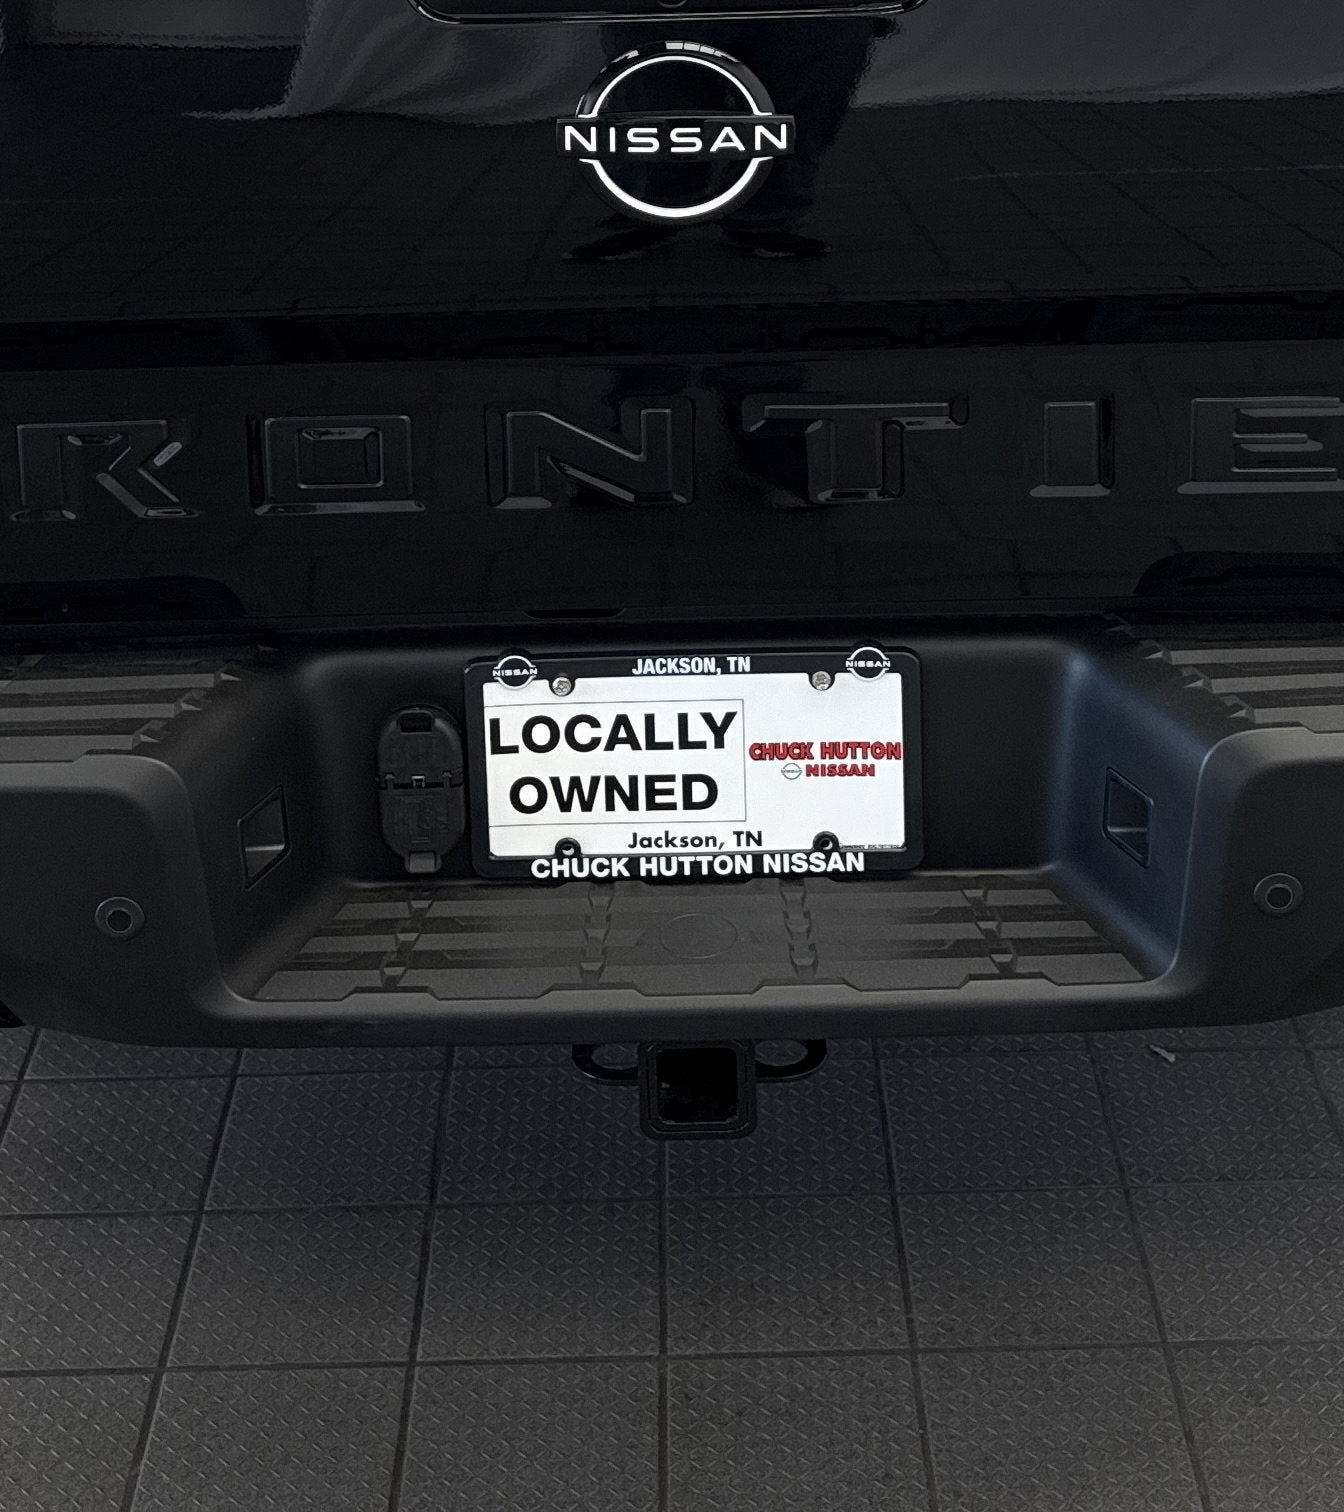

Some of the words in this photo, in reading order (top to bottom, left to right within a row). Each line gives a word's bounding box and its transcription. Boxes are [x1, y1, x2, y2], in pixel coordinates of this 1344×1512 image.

[564, 123, 787, 153] NISSAN
[492, 668, 538, 677] NISSAN
[631, 657, 721, 676] JACKSON,
[727, 656, 751, 673] TN
[845, 660, 891, 668] NISSAN
[489, 711, 738, 755] LOCALLY
[749, 742, 814, 761] CHUCK
[820, 741, 902, 760] HUTTON
[805, 763, 876, 777] NISSAN
[509, 774, 718, 814] OWNED
[628, 830, 725, 850] Jackson,
[733, 830, 763, 847] TN
[531, 857, 631, 878] CHUCK
[639, 854, 753, 877] HUTTON
[763, 852, 865, 874] NISSAN
